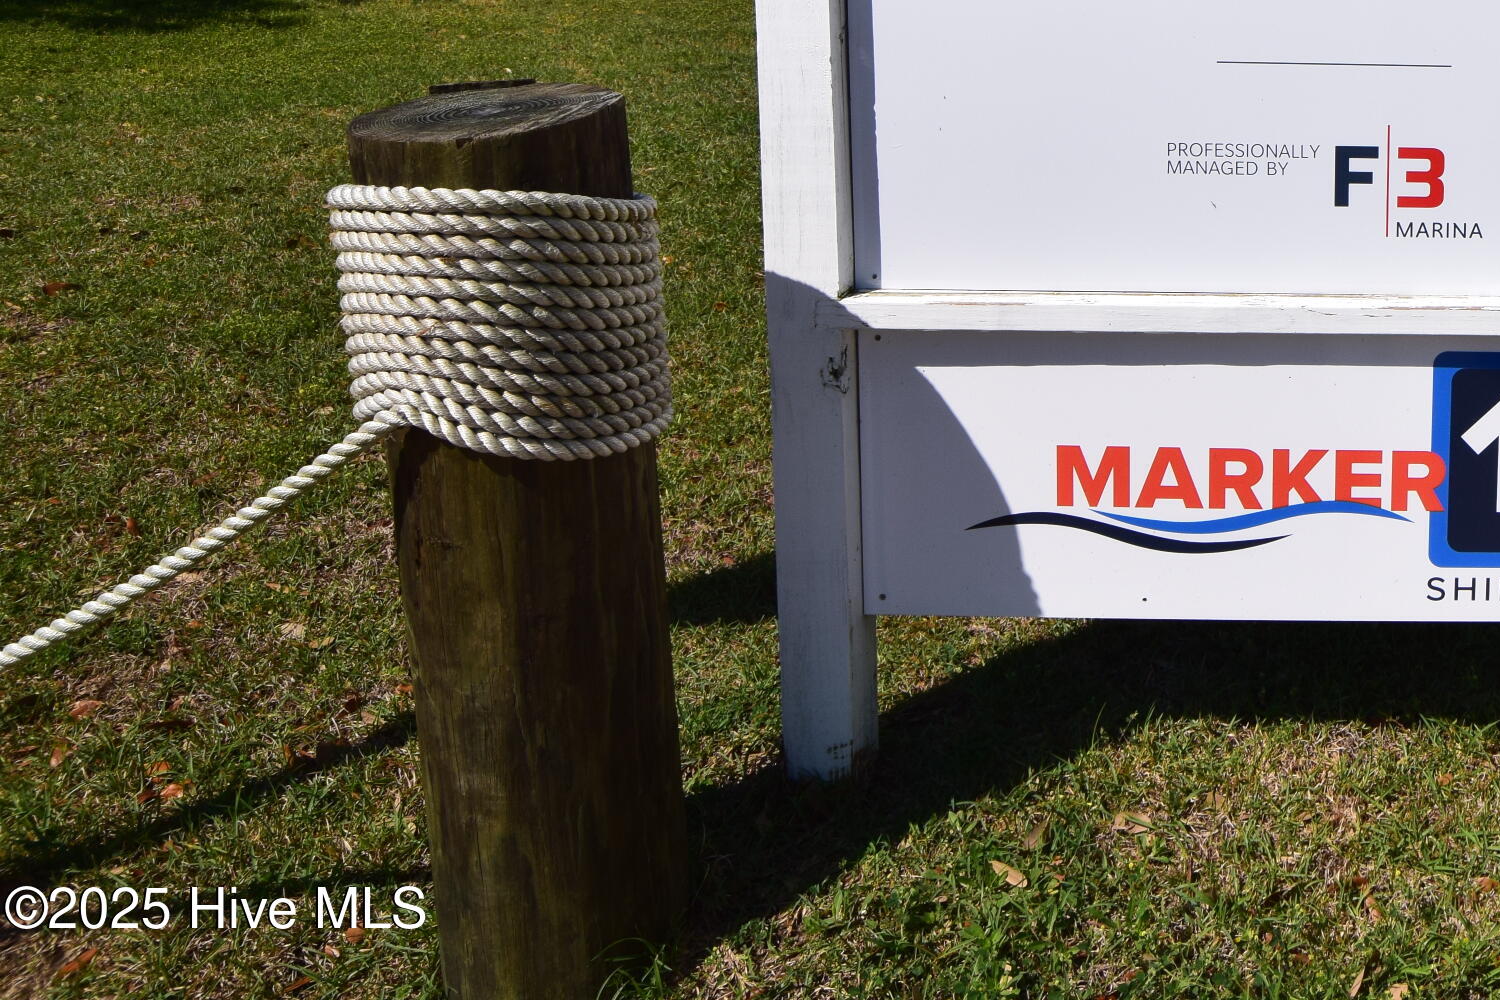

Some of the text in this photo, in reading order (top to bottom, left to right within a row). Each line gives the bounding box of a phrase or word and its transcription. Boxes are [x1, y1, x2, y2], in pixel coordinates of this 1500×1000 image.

[1166, 142, 1321, 159] PROFESSIONALLY
[1166, 160, 1289, 176] MANAGED BY
[1395, 221, 1484, 239] MARINA
[1055, 445, 1447, 512] MARKER
